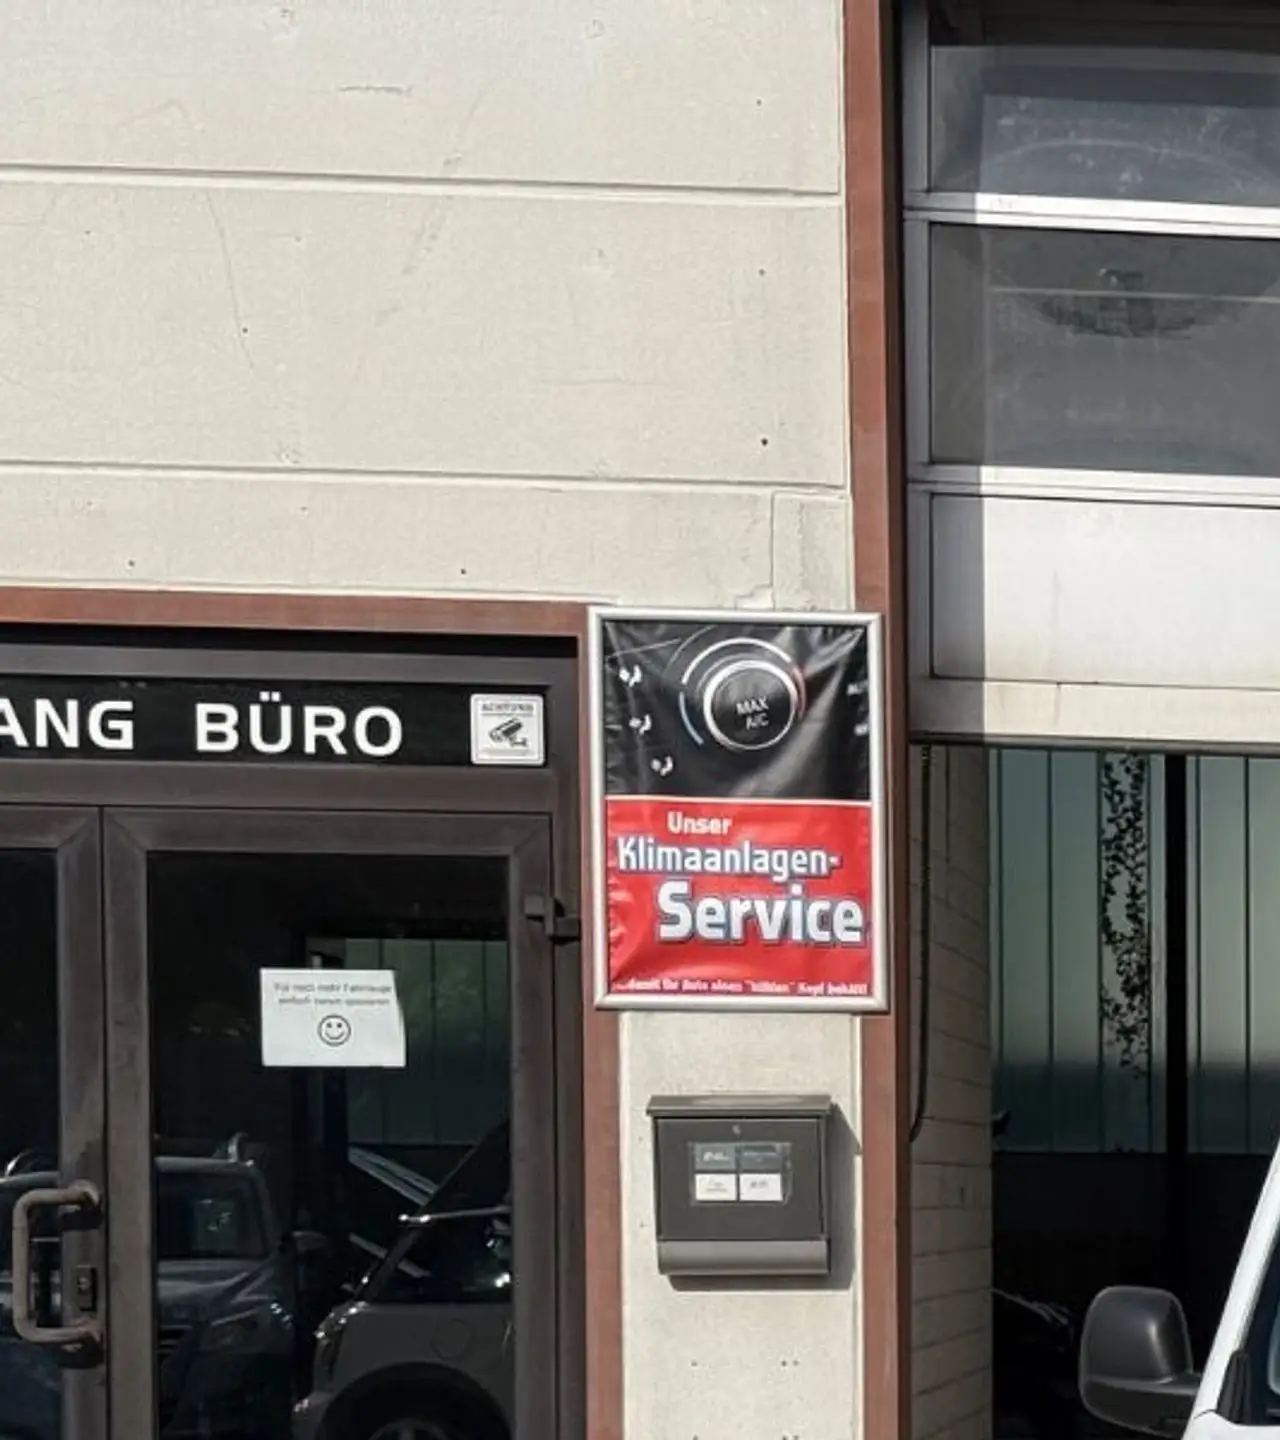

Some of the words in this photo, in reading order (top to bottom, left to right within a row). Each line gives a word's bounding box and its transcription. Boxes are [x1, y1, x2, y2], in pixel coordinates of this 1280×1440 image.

[195, 690, 402, 757] BÜRO
[735, 695, 770, 717] MAX
[666, 811, 732, 835] Unser
[617, 836, 841, 882] Klimaanlagen-
[657, 880, 864, 943] Service
